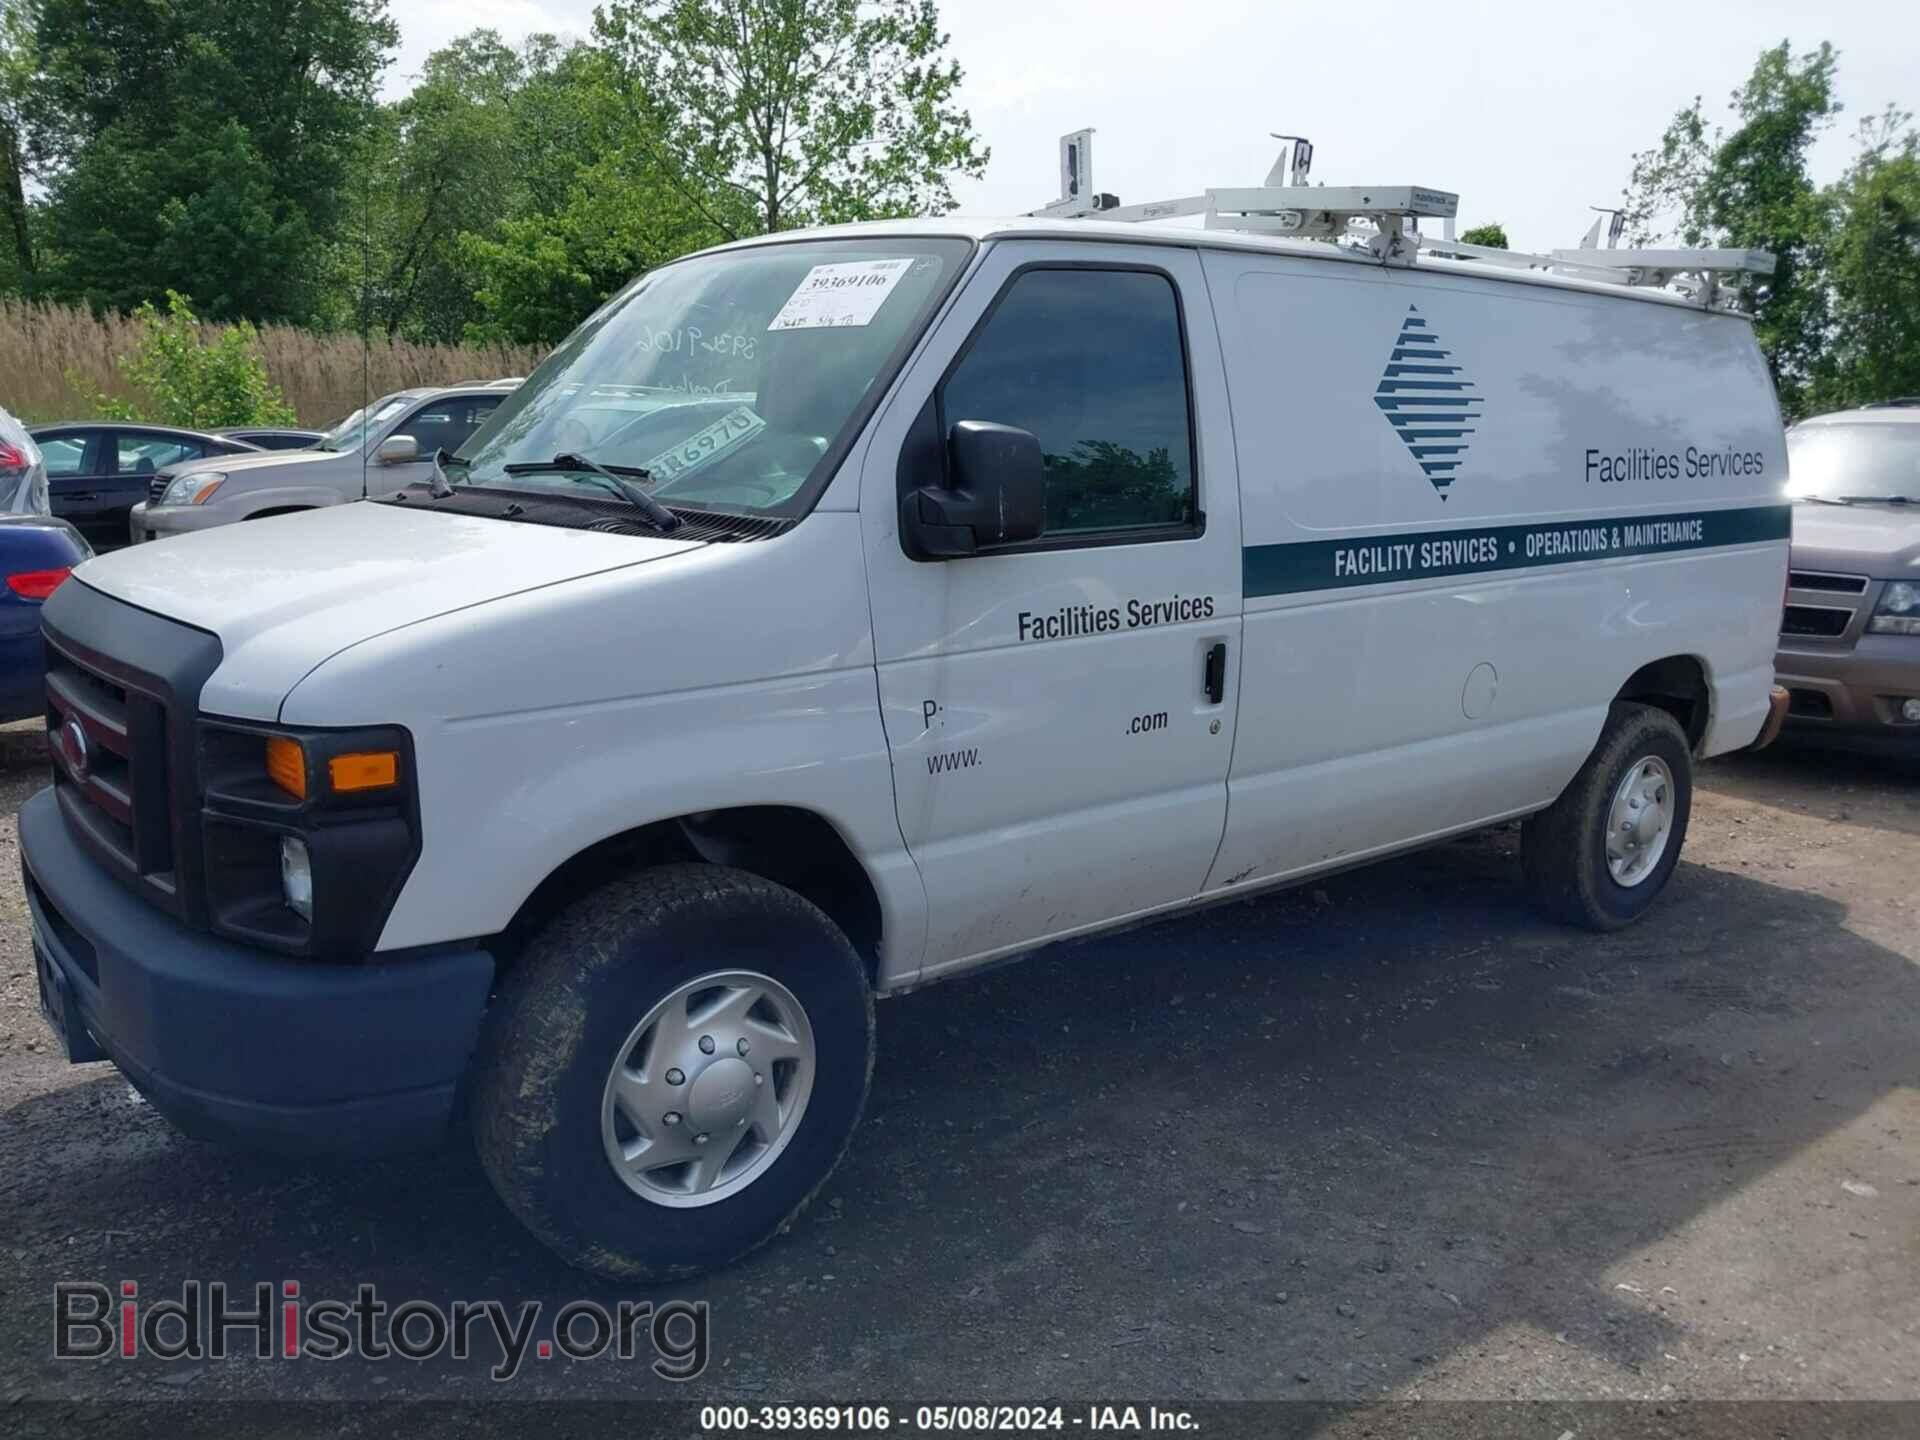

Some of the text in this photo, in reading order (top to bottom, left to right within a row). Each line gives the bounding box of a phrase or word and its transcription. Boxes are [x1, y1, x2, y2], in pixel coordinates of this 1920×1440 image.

[810, 274, 887, 289] 39369106
[1585, 444, 1764, 483] Facilities Services
[1335, 520, 1703, 577] FACILITY SERVICES OPERATIONS & MAINTENANCE
[1018, 595, 1214, 641] Facilities Services
[923, 700, 945, 729] P:
[1125, 711, 1168, 735] .com
[927, 748, 982, 775] www.
